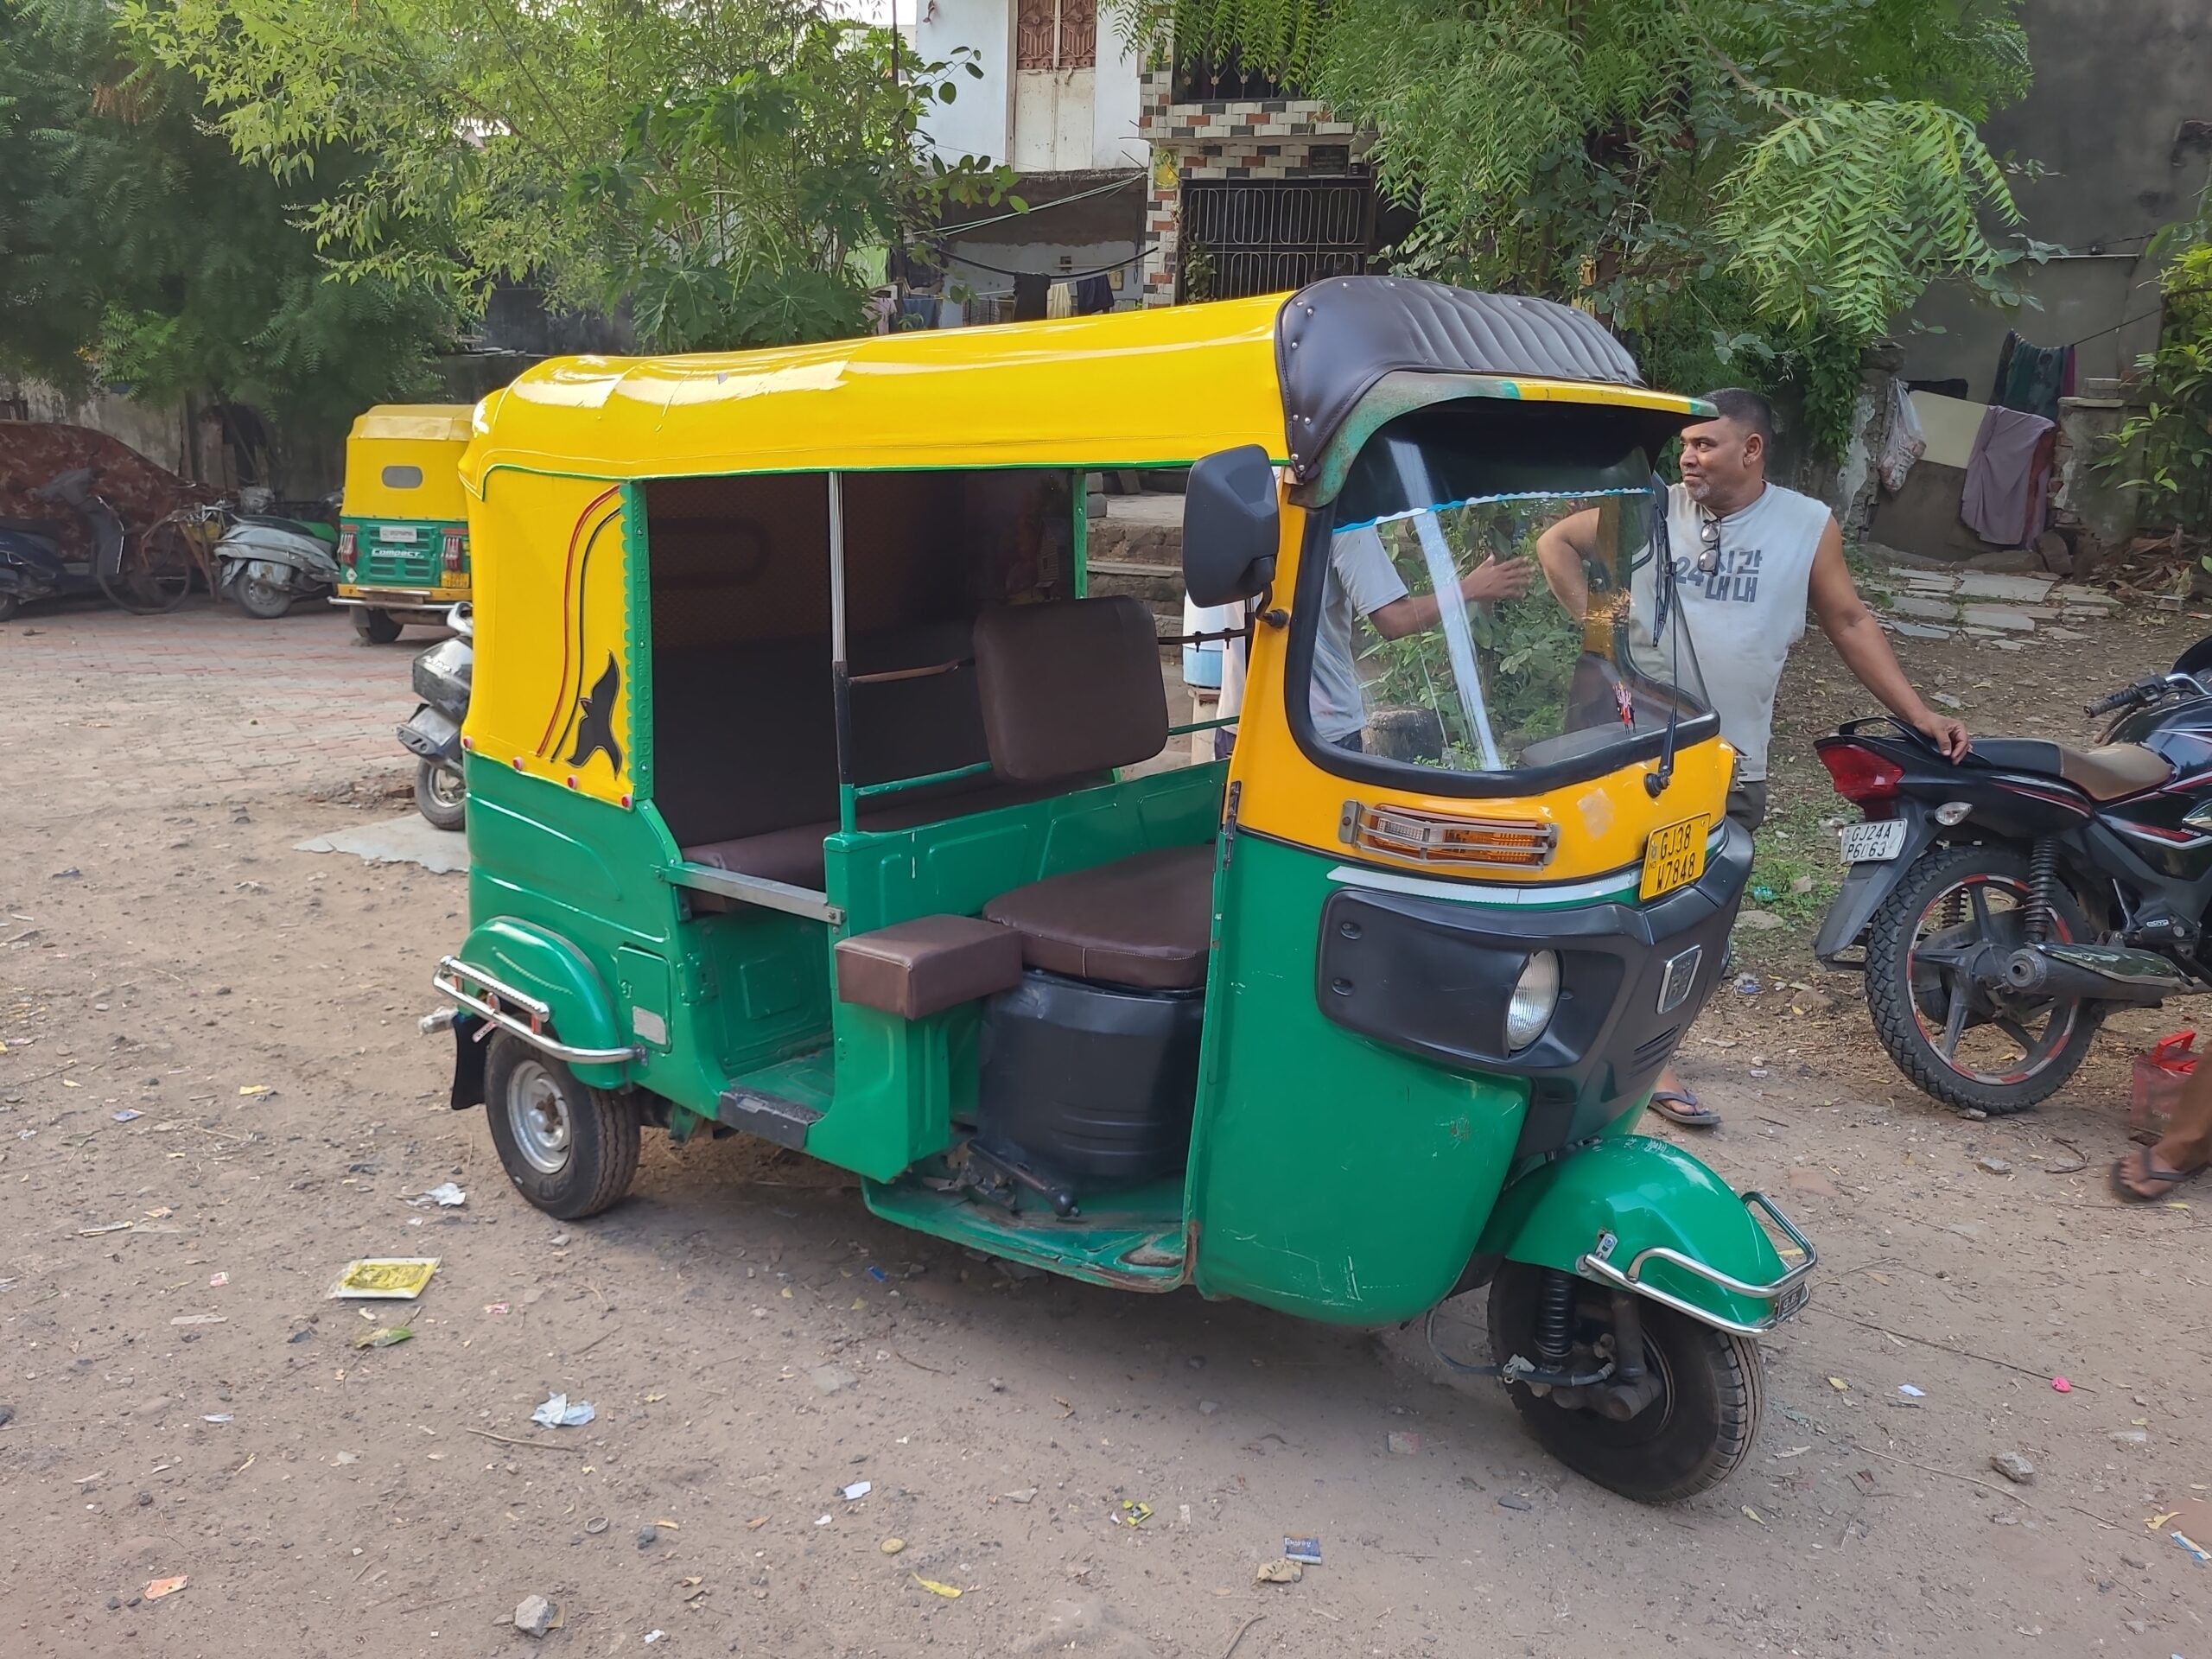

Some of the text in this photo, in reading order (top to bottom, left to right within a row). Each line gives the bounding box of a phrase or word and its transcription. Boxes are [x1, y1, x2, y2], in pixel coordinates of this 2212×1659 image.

[1661, 823, 1691, 861] GJ38
[1852, 823, 1892, 842] GJ24A
[1846, 842, 1886, 861] P6063
